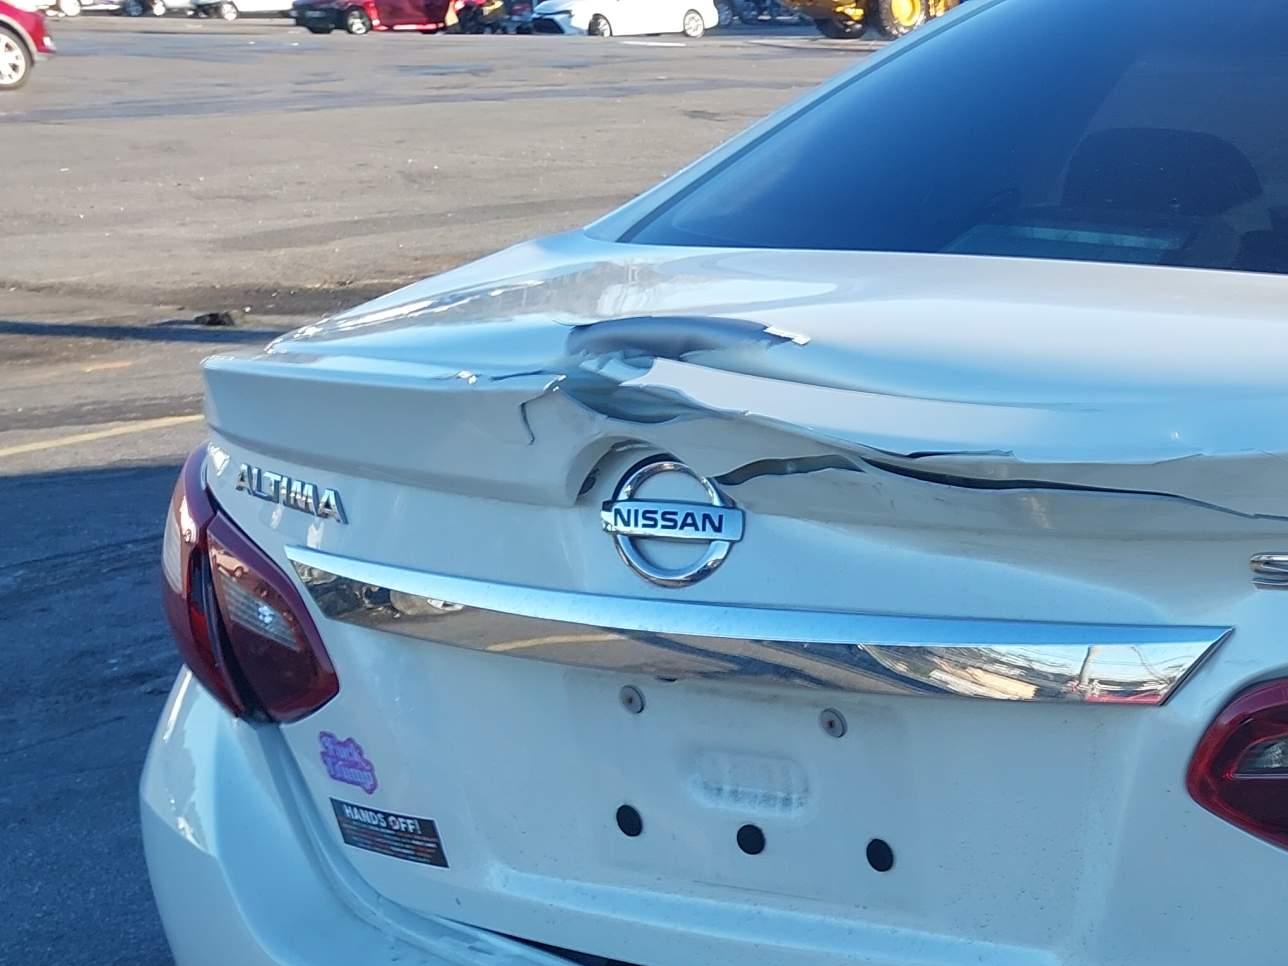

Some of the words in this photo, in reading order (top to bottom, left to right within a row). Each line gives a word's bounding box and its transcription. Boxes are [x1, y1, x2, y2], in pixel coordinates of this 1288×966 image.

[236, 463, 348, 524] ALTIMA
[613, 507, 724, 533] NISSAN
[343, 804, 387, 827] HANDS
[388, 815, 423, 834] OFF!
